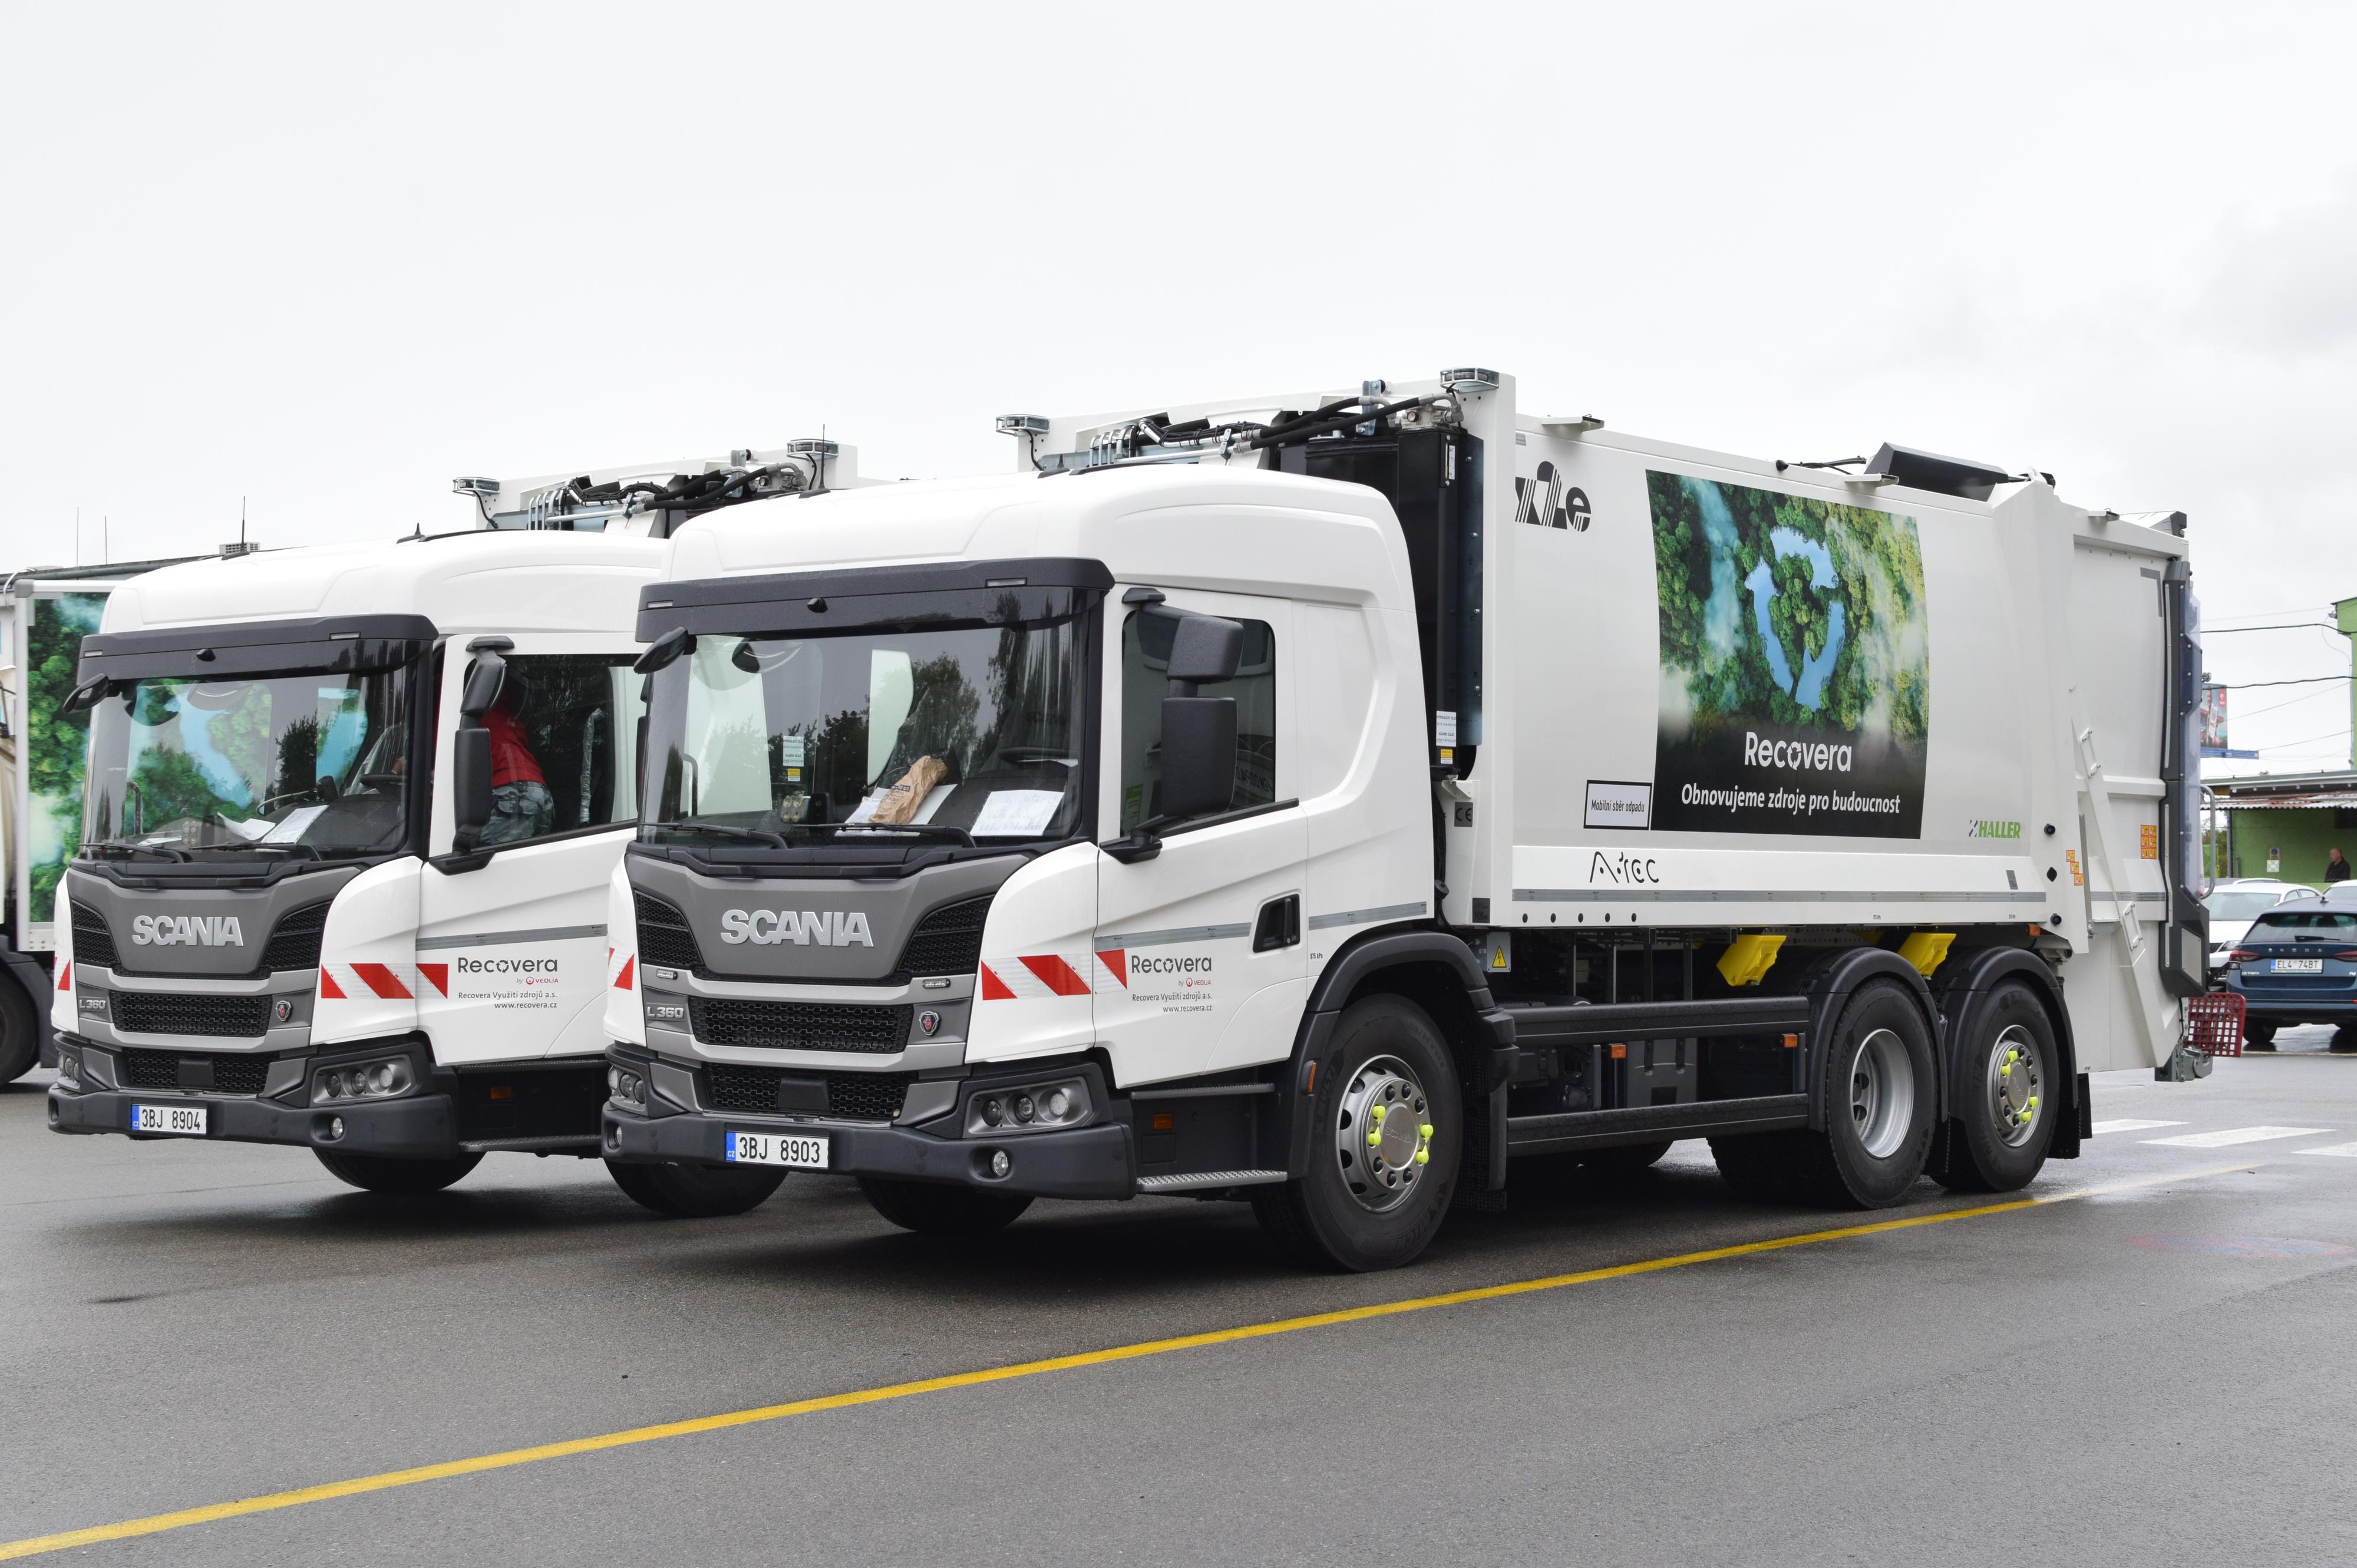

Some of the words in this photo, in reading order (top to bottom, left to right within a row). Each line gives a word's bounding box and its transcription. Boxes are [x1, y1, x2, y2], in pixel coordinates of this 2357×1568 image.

[1745, 731, 1852, 771] Recovera
[1592, 800, 1612, 811] Mobilní
[1612, 801, 1624, 811] sběr
[1625, 801, 1645, 814] odpadu
[1681, 783, 1765, 813] Obnovujeme
[1768, 787, 1805, 815] zdroje
[1808, 795, 1829, 816] pro
[1832, 790, 1900, 814] budoucnost
[1978, 820, 2021, 839] HALLER
[132, 915, 243, 946] SCANIA
[721, 909, 874, 947] SCANIA
[458, 957, 558, 973] Recovera
[1131, 955, 1211, 973] Recovera
[2277, 960, 2292, 969] EL4
[2298, 960, 2318, 969] 74BT
[79, 999, 85, 1009] L
[86, 999, 106, 1009] 360
[493, 991, 518, 1001] Využití
[520, 990, 543, 999] zdrojů
[1132, 993, 1159, 1002] Recovera
[1160, 992, 1181, 1003] Využití
[1183, 991, 1201, 1002] zdrojů
[647, 1006, 656, 1017] L
[656, 1006, 684, 1018] 360
[1163, 1005, 1212, 1013] www.recovera.cz
[142, 1108, 163, 1128] 3BJ
[172, 1110, 200, 1130] 8904
[740, 1136, 768, 1160] 3BJ
[780, 1139, 820, 1163] 8903
